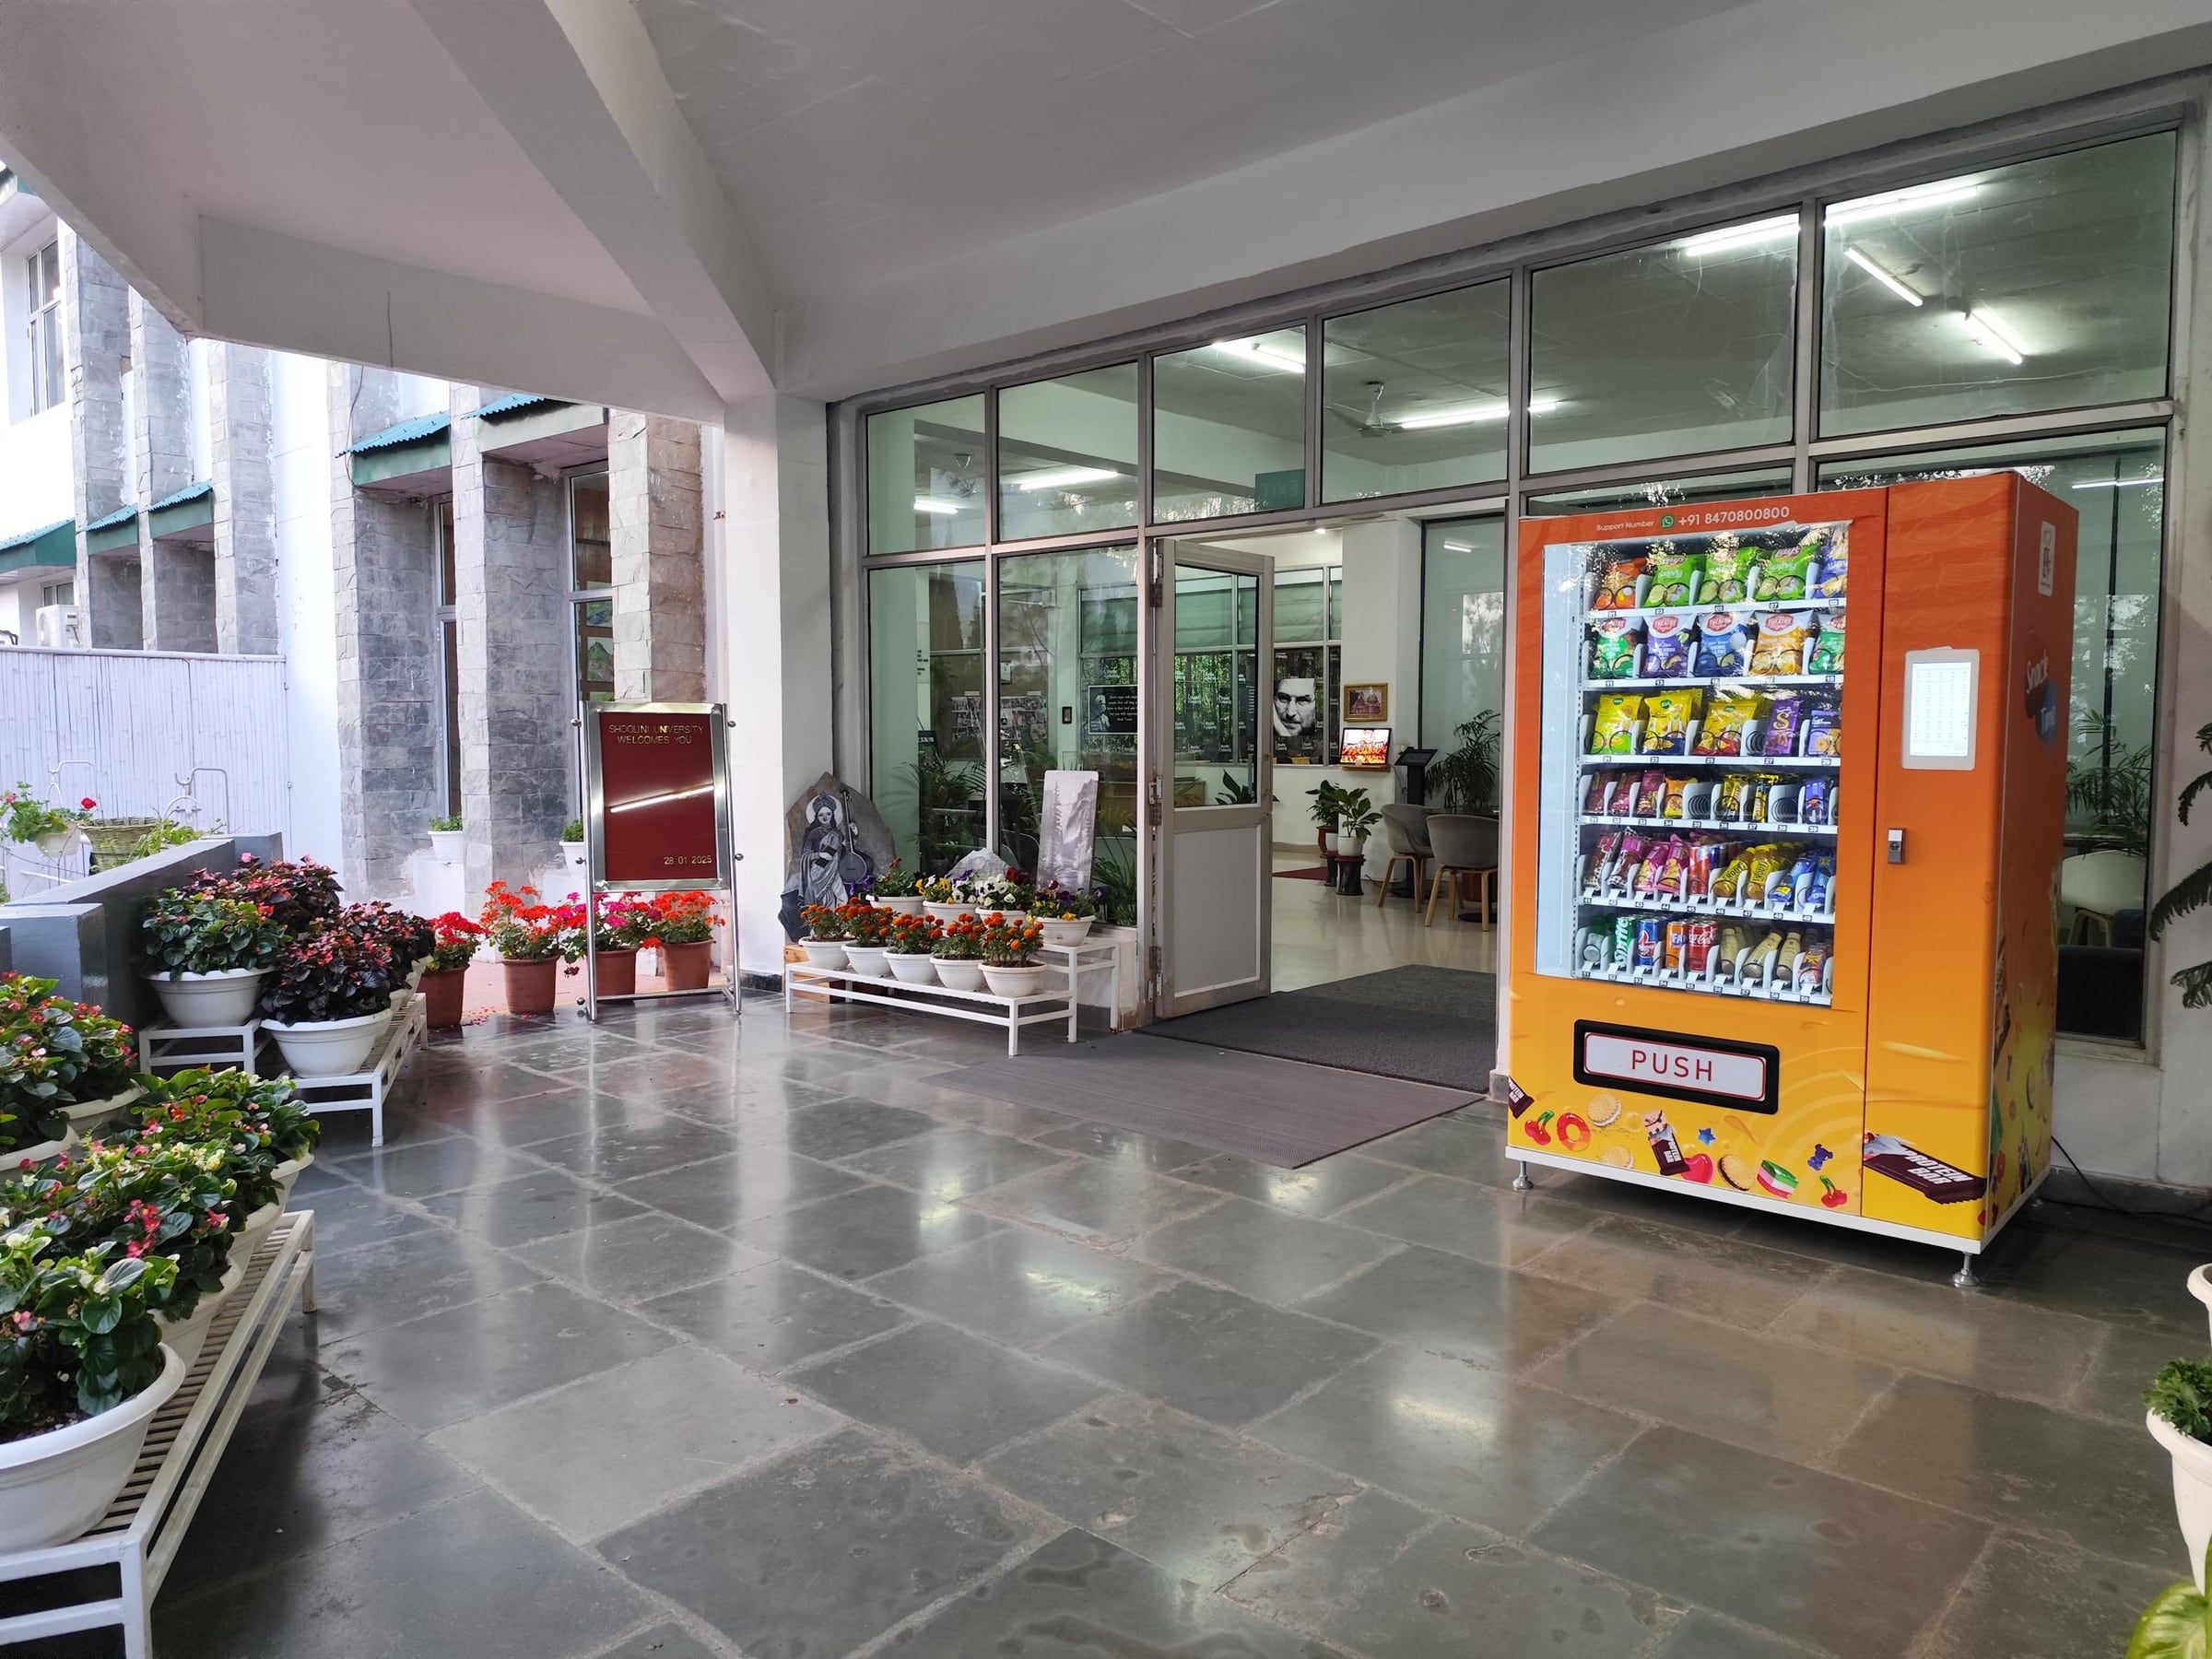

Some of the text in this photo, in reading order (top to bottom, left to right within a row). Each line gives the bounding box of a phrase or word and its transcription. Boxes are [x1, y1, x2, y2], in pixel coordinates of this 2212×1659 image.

[1596, 506, 1790, 532] Support Number +91 8470800800
[608, 724, 703, 734] SHOOLINI UNIVERSITY
[617, 735, 691, 745] WELCOMES YOU
[677, 855, 687, 865] 01
[691, 854, 712, 865] 2025
[1631, 1049, 1712, 1082] PUSH
[1903, 1148, 1974, 1182] PROTEIN
[1907, 1167, 1952, 1184] BAR
